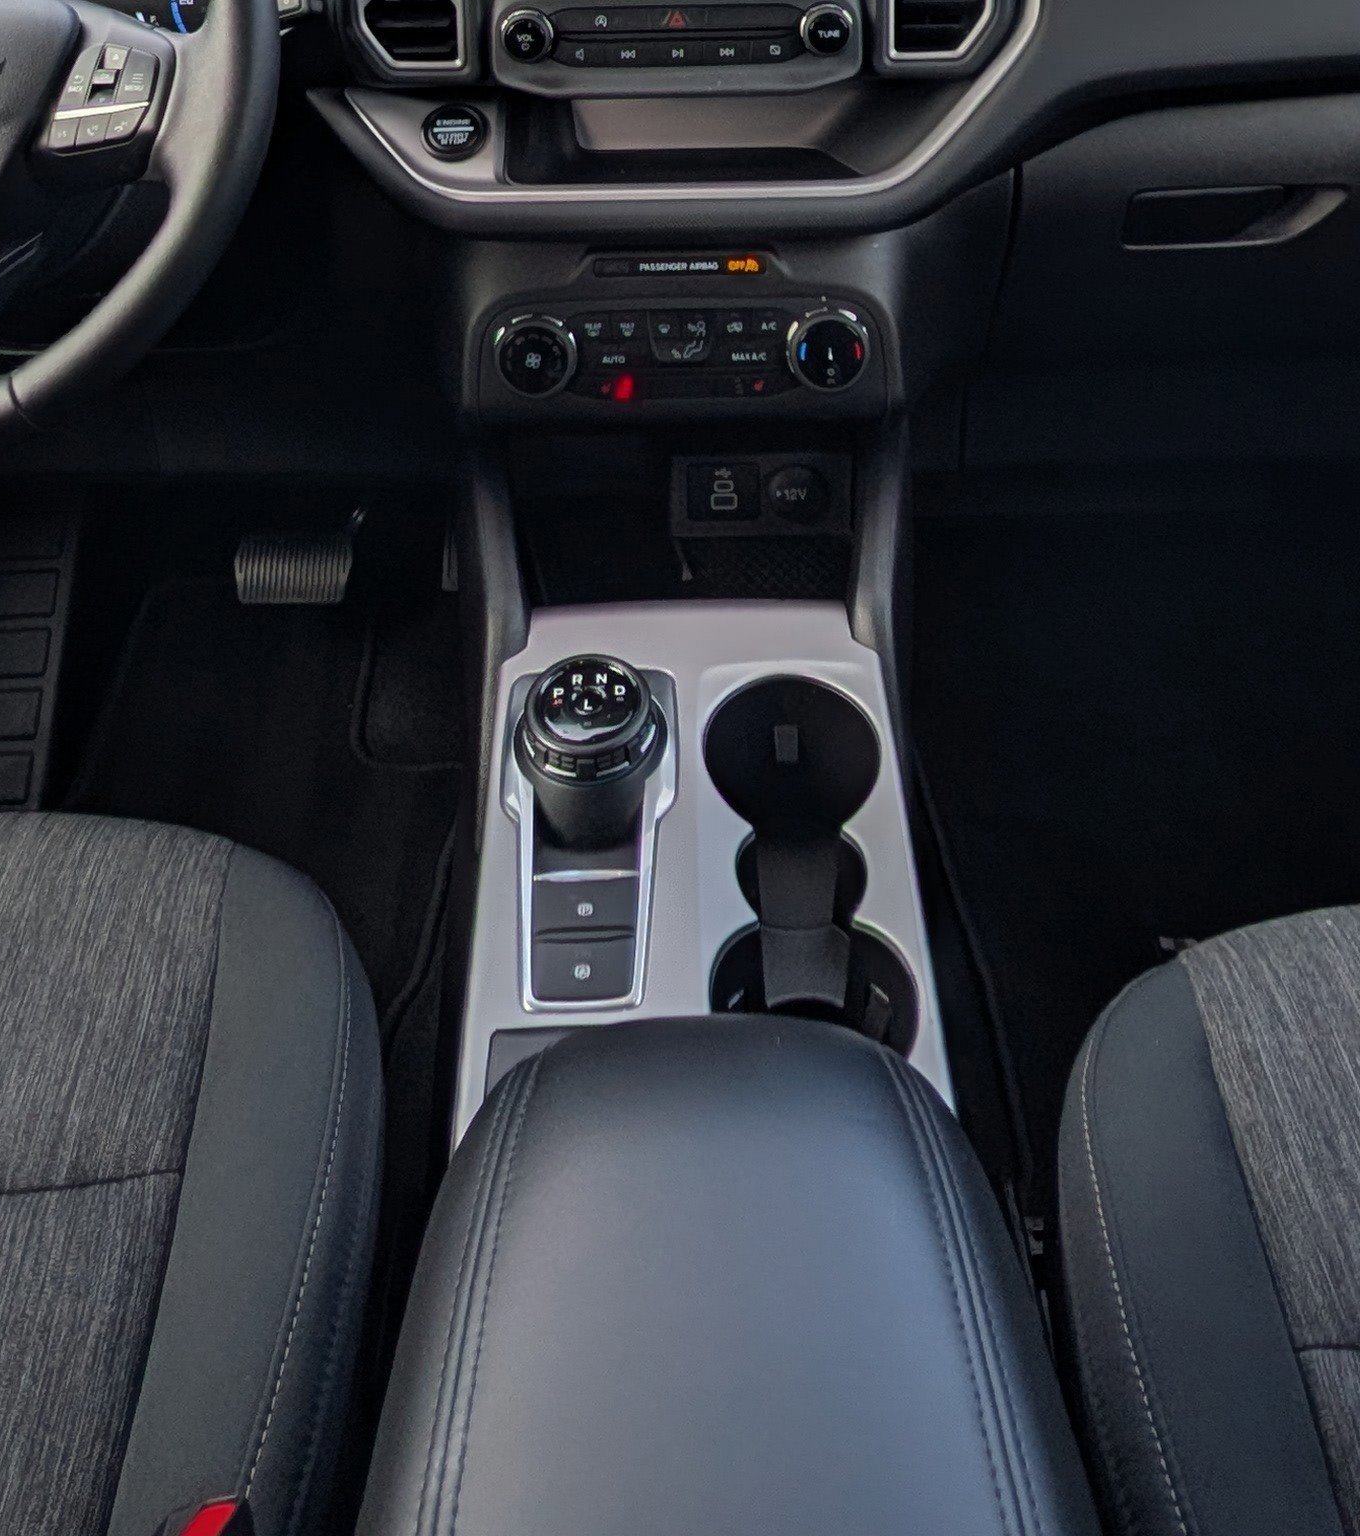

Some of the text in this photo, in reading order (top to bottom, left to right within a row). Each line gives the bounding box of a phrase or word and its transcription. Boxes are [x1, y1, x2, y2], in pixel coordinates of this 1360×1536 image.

[516, 33, 535, 43] VOL
[818, 30, 840, 39] TUNE
[639, 261, 719, 272] PASSENGER AIRBAG
[760, 321, 778, 331] A/C
[602, 355, 626, 364] AUTO
[731, 352, 767, 362] MAX A/C
[783, 487, 807, 501] 12V
[572, 673, 583, 686] R
[595, 672, 608, 684] N
[553, 687, 565, 699] P
[614, 685, 626, 696] D
[583, 699, 593, 711] L
